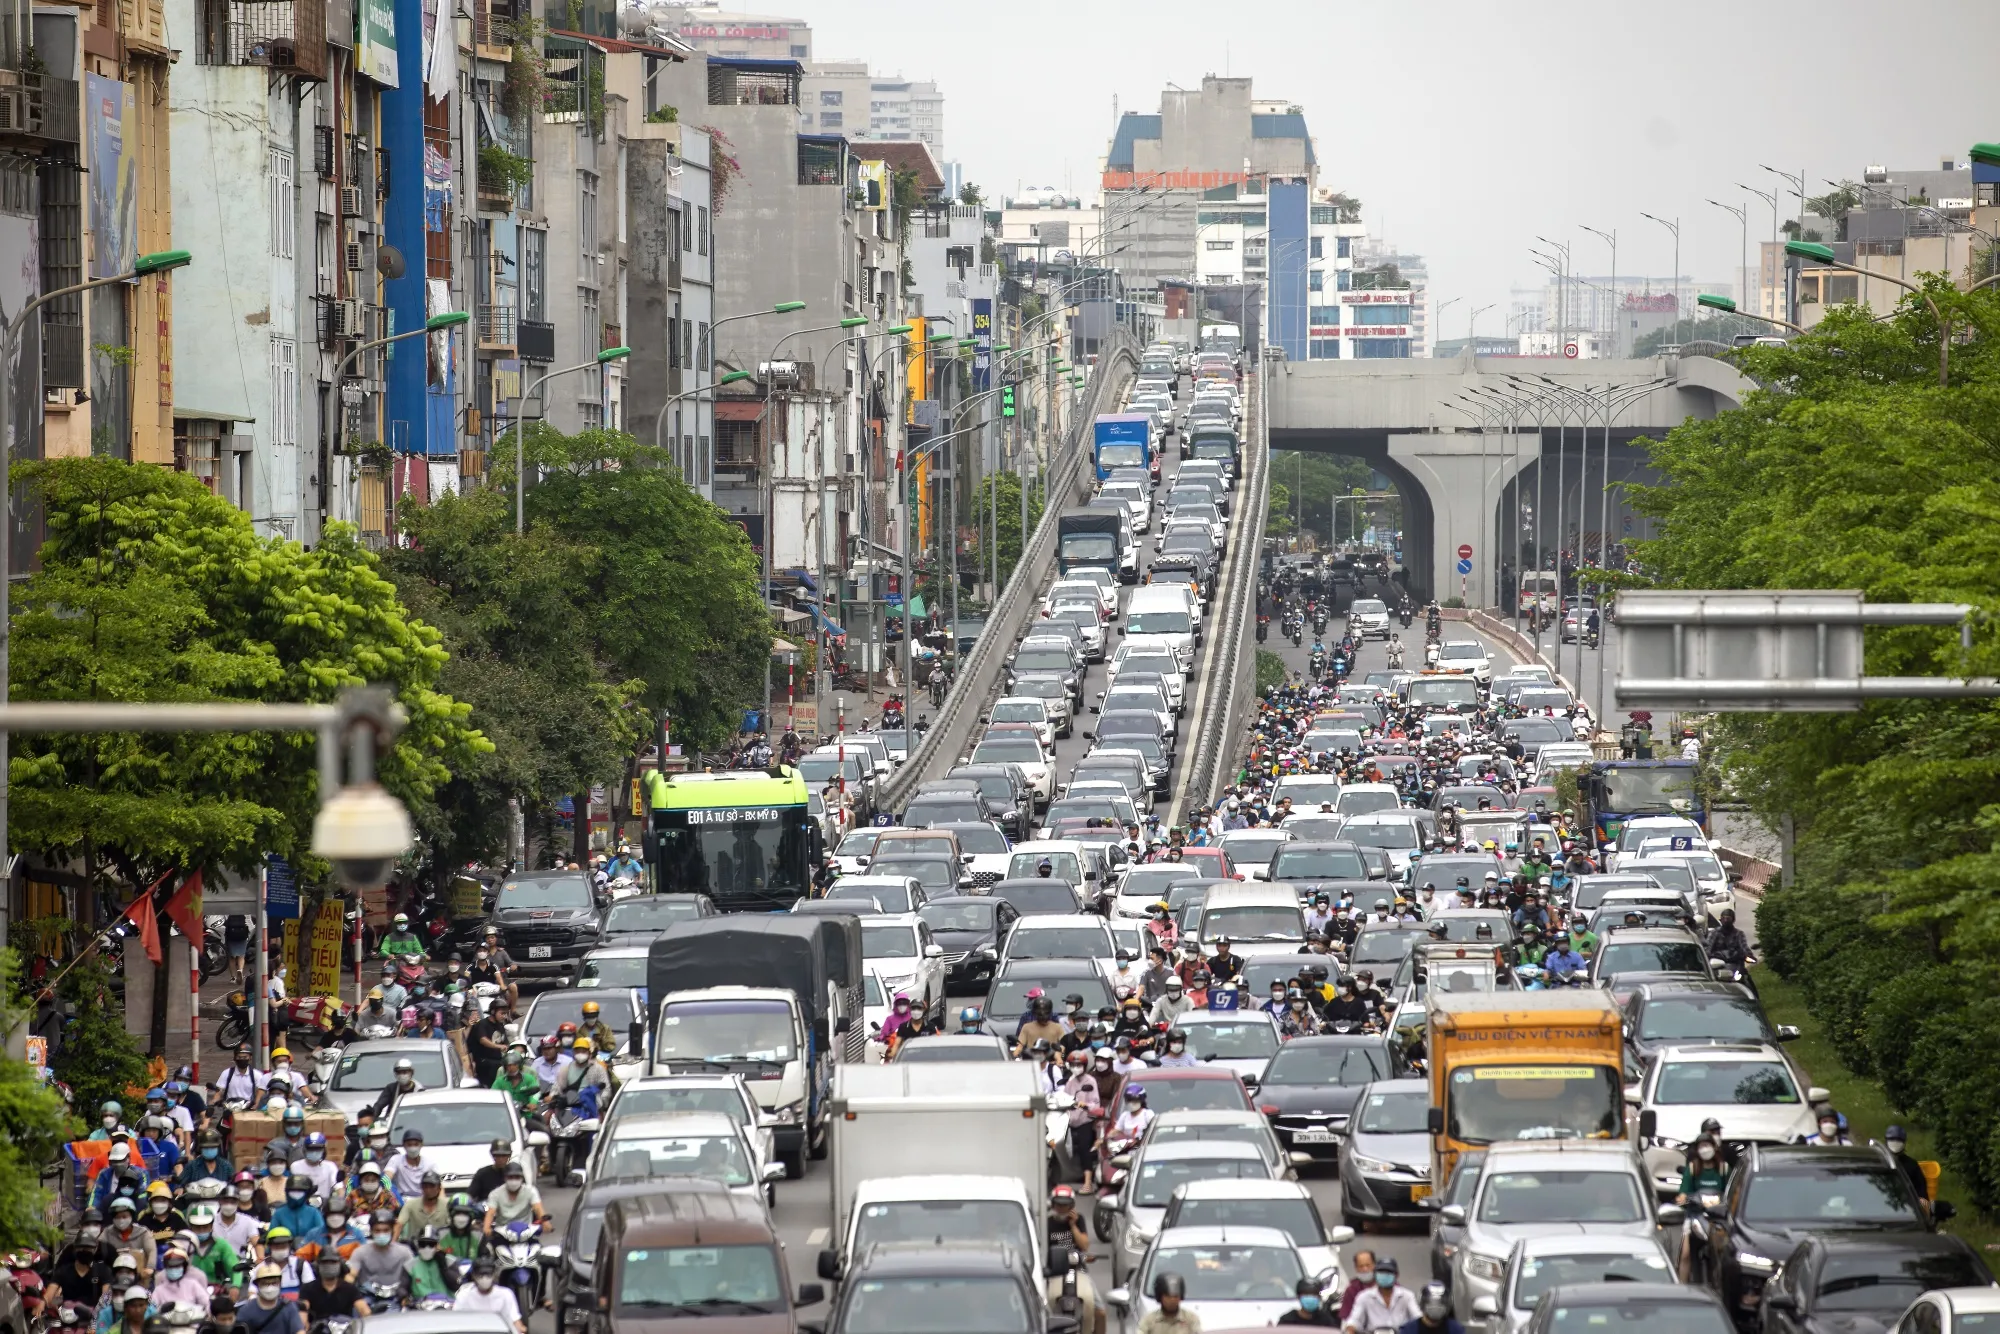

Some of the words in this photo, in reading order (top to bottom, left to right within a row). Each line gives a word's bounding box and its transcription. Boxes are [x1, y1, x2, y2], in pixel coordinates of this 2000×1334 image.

[974, 314, 990, 329] 354
[687, 811, 704, 825] E01
[1215, 992, 1232, 1009] G7
[1457, 1030, 1488, 1042] BƯU
[1492, 1029, 1526, 1044] ĐIỆN
